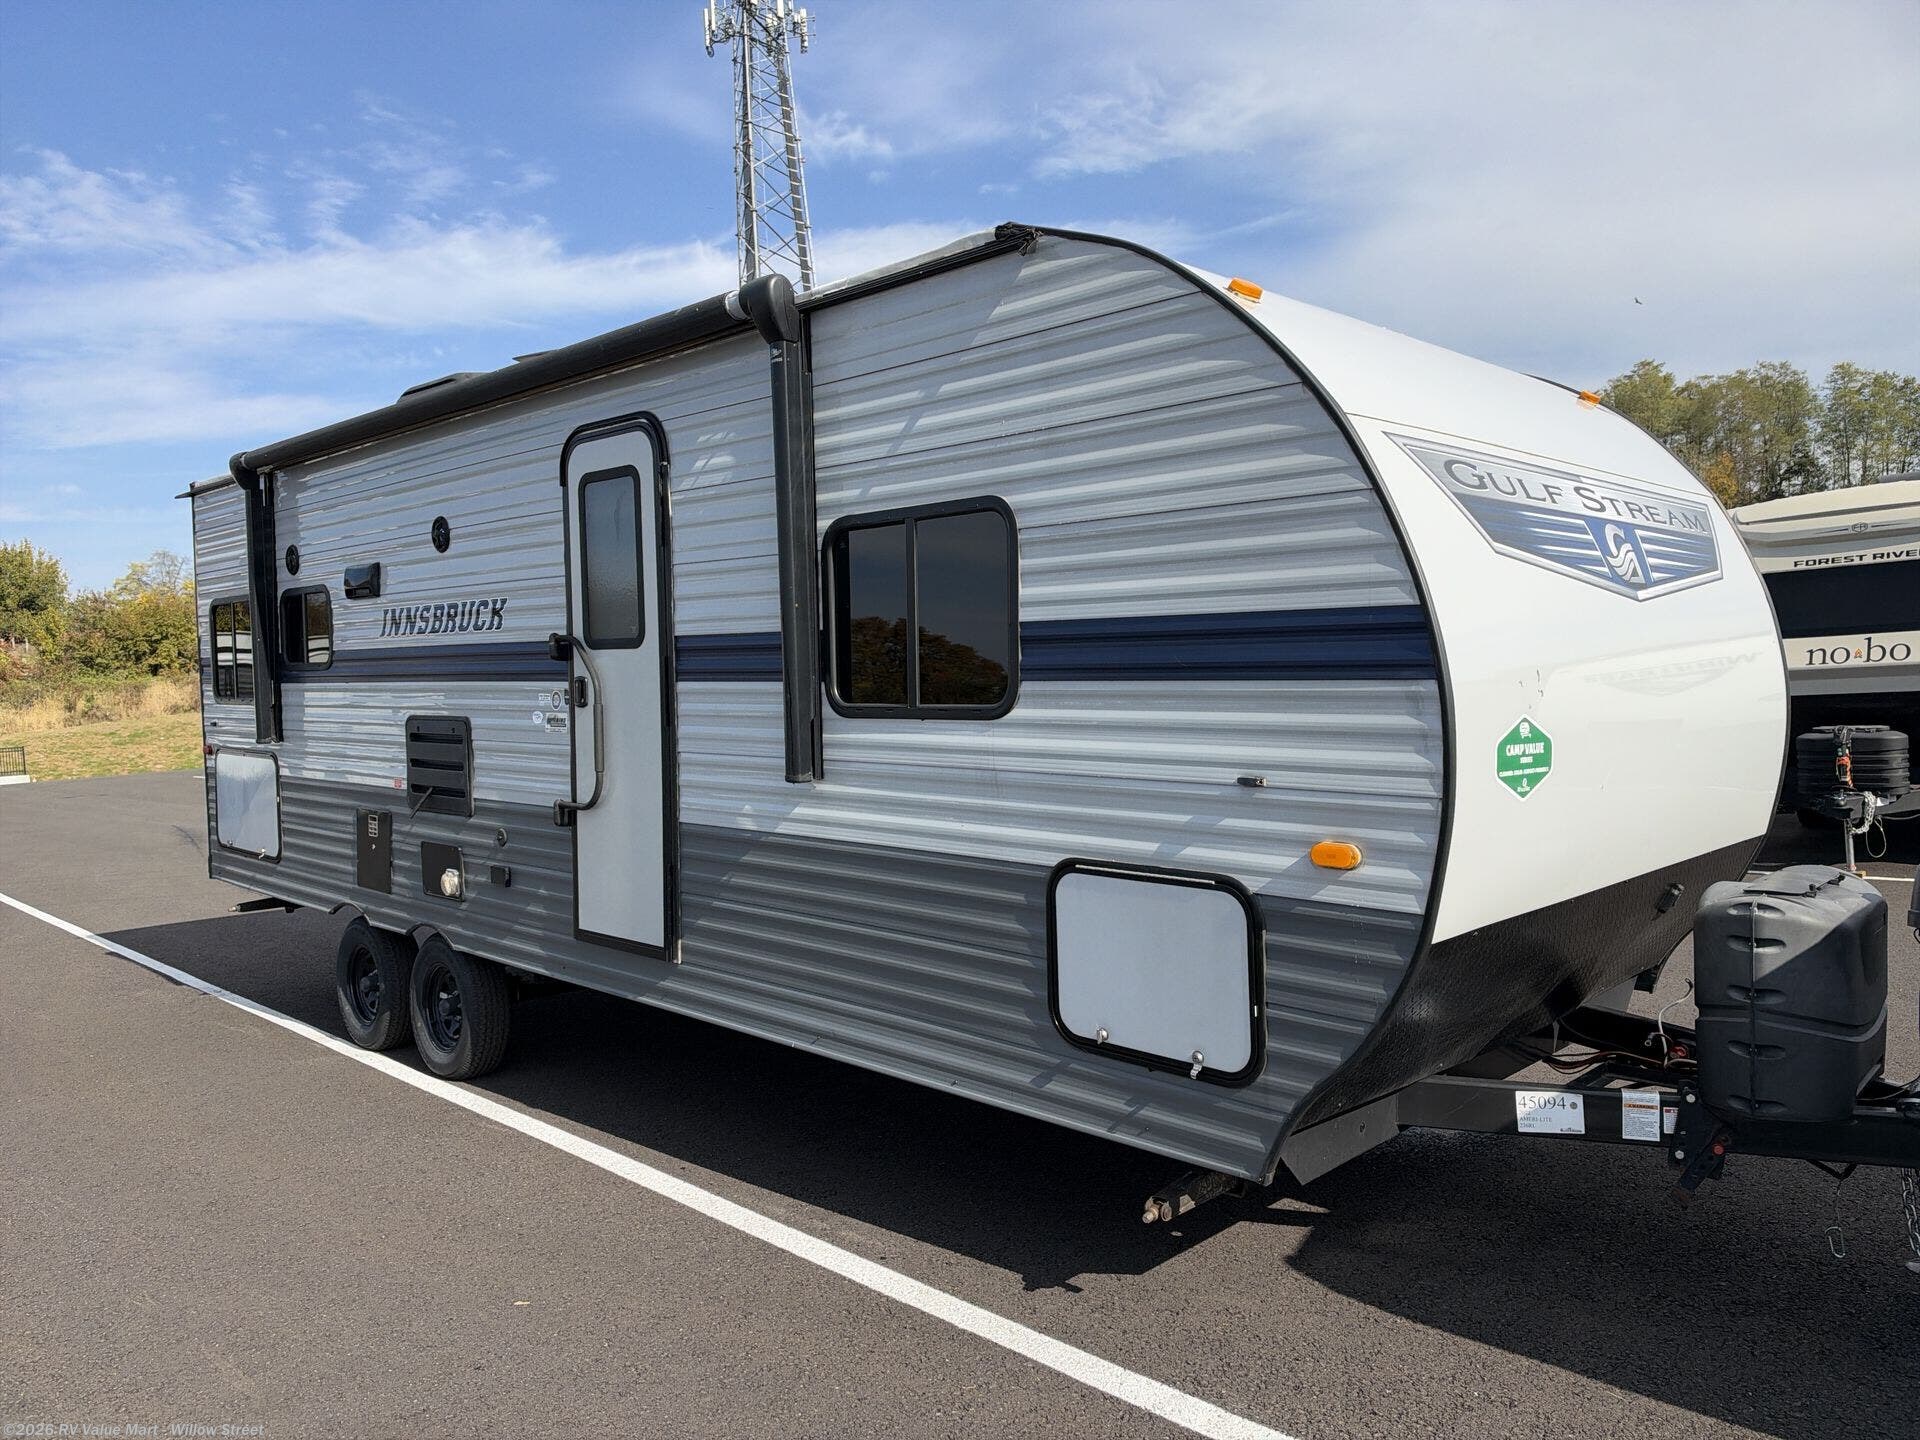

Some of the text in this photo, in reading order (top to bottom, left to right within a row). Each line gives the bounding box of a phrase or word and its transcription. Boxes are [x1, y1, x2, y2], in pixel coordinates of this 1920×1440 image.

[1444, 459, 1710, 535] GULF STREAM
[1793, 548, 1920, 568] FOREST RIVE
[379, 598, 508, 638] INNSBRUCK
[1505, 742, 1545, 757] CAMP VALUE
[1518, 1095, 1567, 1110] 45094
